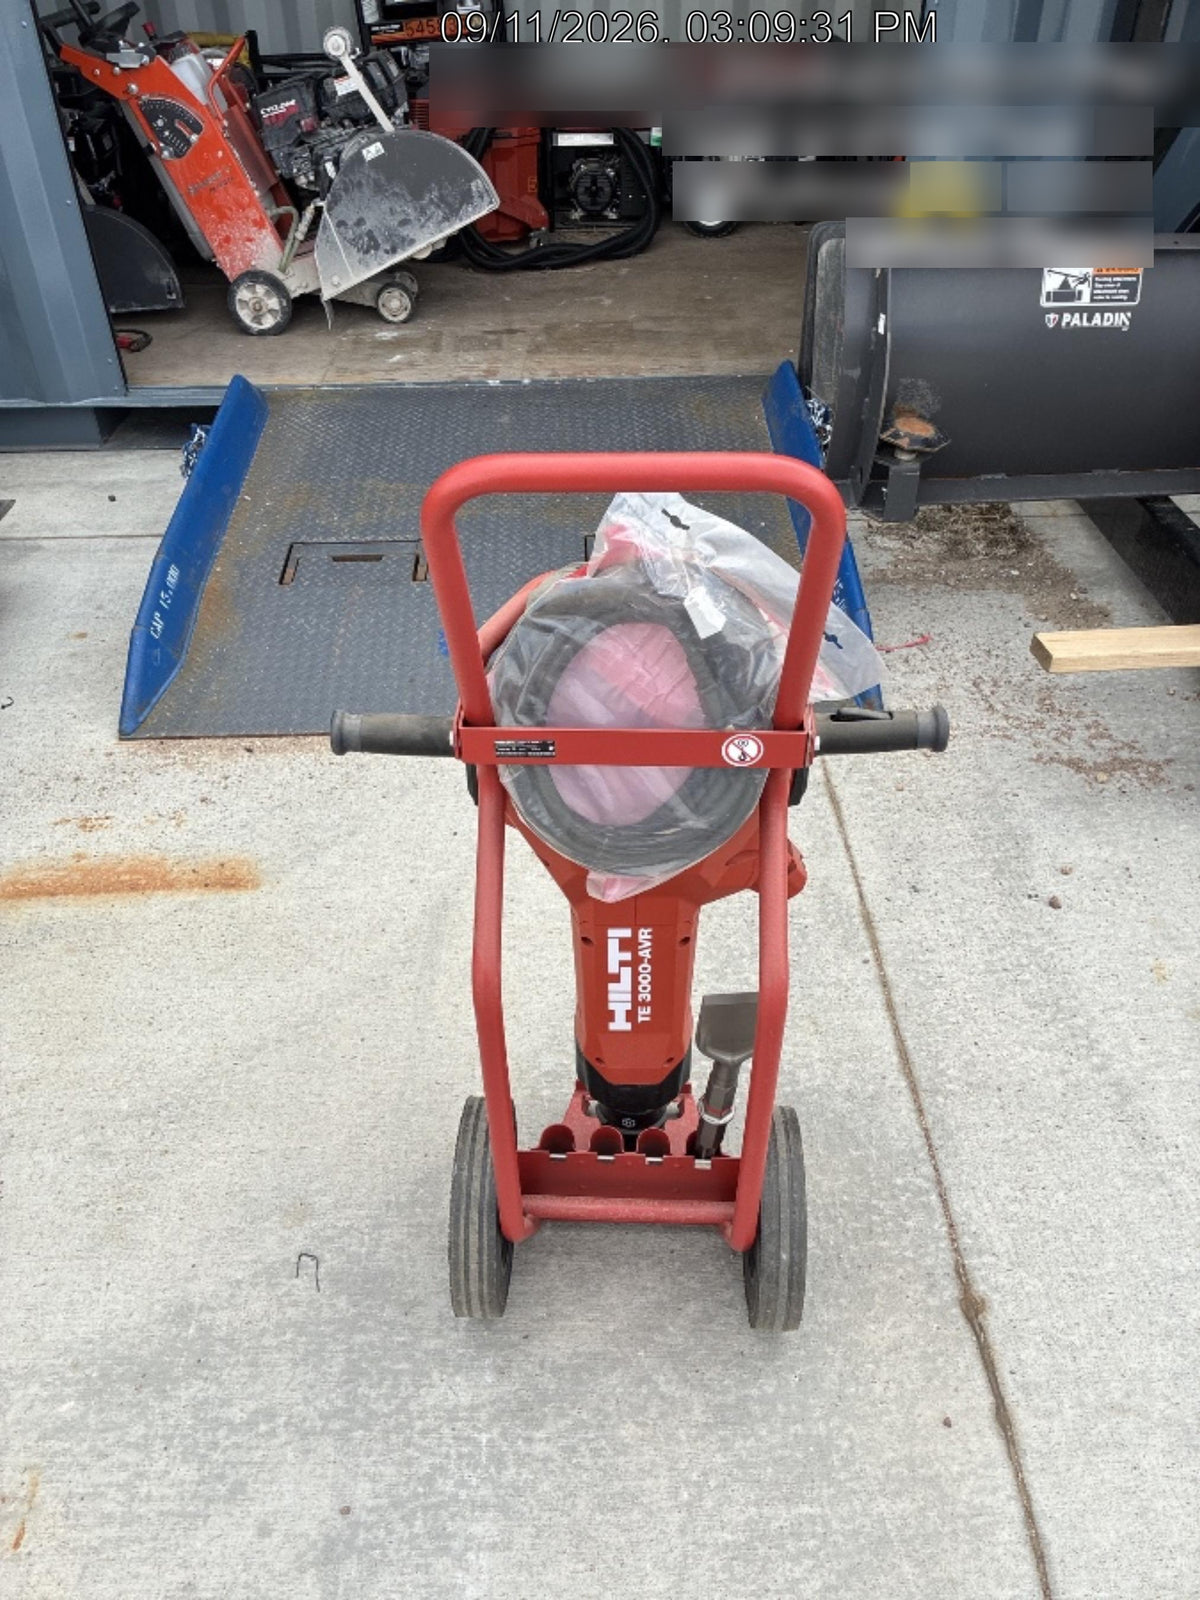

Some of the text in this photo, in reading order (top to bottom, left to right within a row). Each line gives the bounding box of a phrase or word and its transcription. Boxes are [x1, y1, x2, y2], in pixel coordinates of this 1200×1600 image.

[1061, 311, 1132, 328] PALADIN
[149, 611, 165, 640] CAP
[607, 928, 632, 1032] HILTI
[637, 927, 654, 1024] TE 3000-AVR
